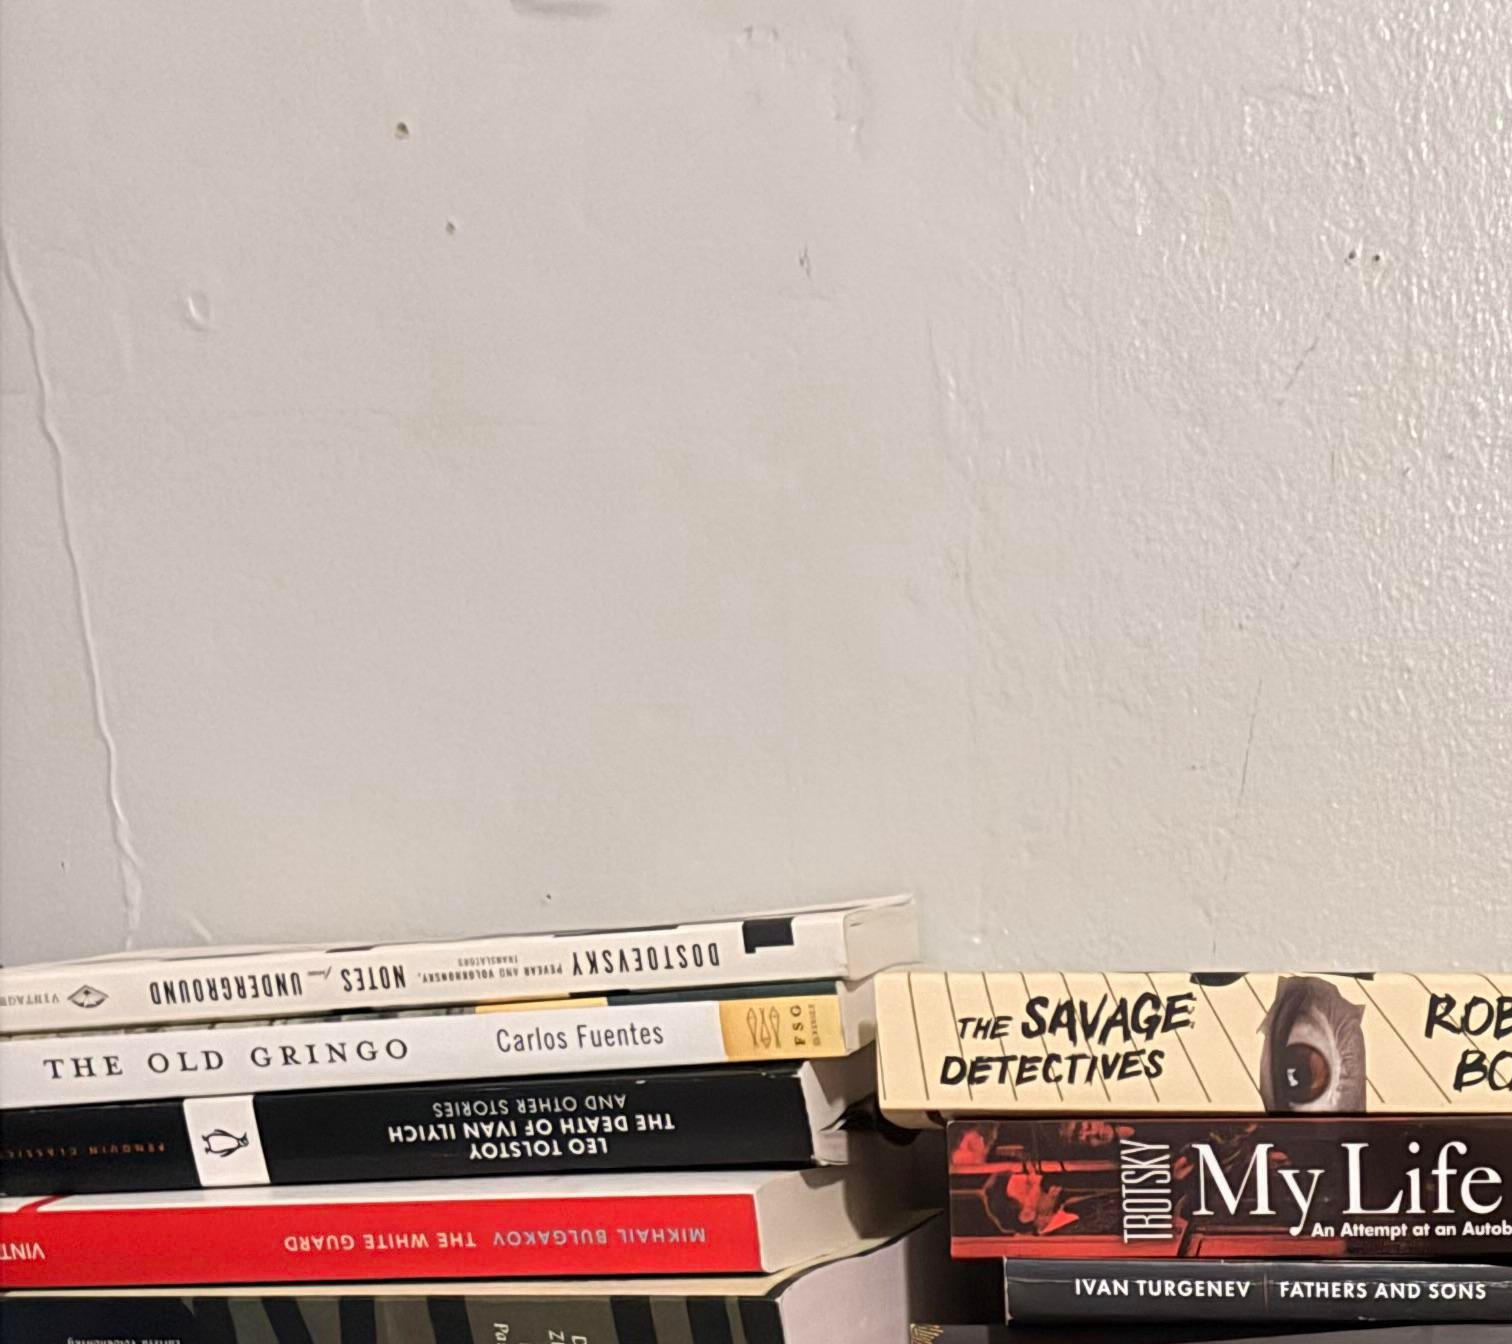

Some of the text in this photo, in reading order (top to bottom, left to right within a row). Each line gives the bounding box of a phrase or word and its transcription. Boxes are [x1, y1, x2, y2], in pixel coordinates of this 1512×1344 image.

[573, 943, 719, 976] DOSTOEVSKY
[497, 1023, 663, 1052] Carlos Fuentes
[43, 1039, 407, 1079] THE OLD GRINGO
[433, 1095, 625, 1118] AND OTHER STORIES
[389, 1114, 675, 1142] THE DEATH OF IVAN ILYICH
[470, 1138, 607, 1159] LEO TOLSTOY
[1191, 1142, 1502, 1236] My Life
[285, 1233, 476, 1251] THE WHITE GUARD
[494, 1229, 705, 1245] MIKHAIL BULGAKOV
[1311, 1223, 1334, 1237] An
[1341, 1222, 1407, 1240] Attempt
[1412, 1223, 1430, 1236] at
[1435, 1226, 1456, 1236] an
[1076, 1279, 1250, 1297] IVAN TURGENEV
[1277, 1281, 1485, 1299] FATHERS AND SONS
